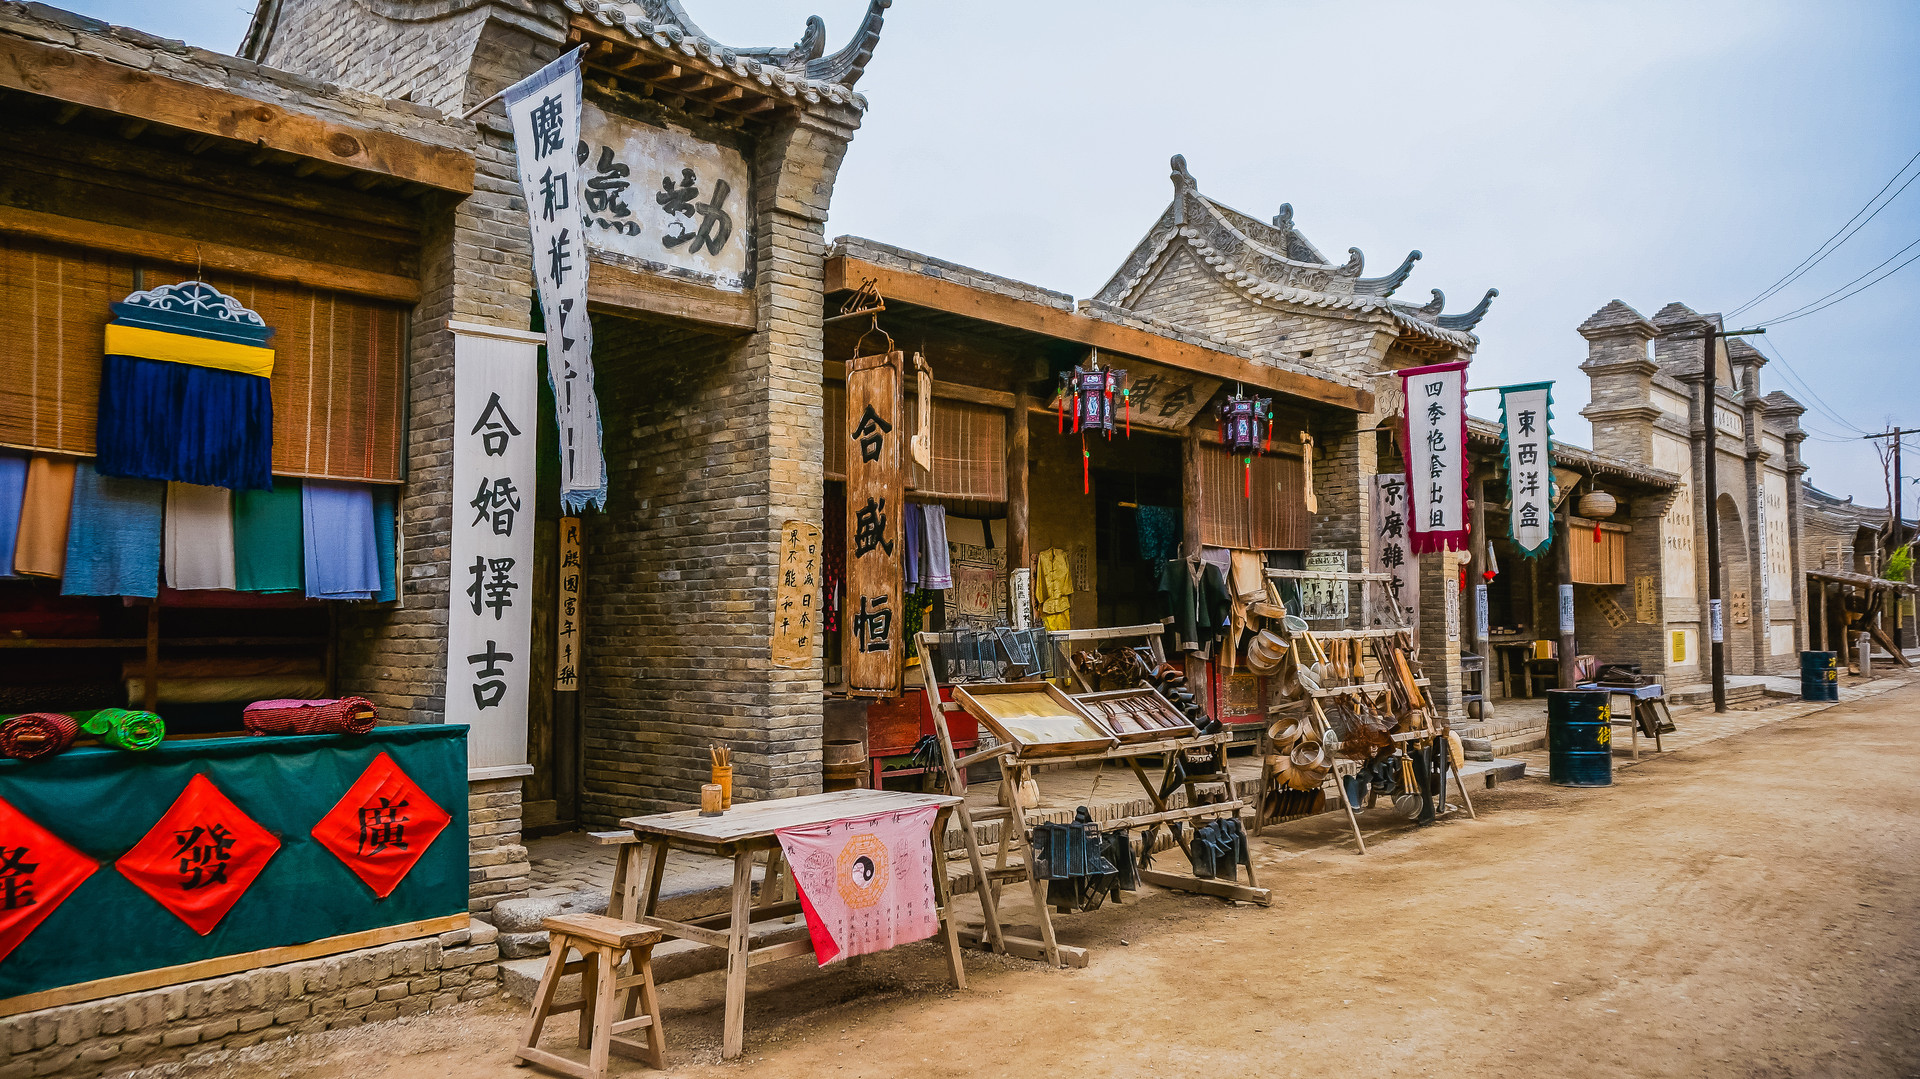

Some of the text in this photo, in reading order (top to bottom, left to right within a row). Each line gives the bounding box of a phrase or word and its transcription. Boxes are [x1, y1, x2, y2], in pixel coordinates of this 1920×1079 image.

[466, 391, 522, 711] 合婚擇吉
[779, 529, 800, 637] 界不能和平
[171, 823, 236, 891] 發
[356, 797, 410, 858] 廣
